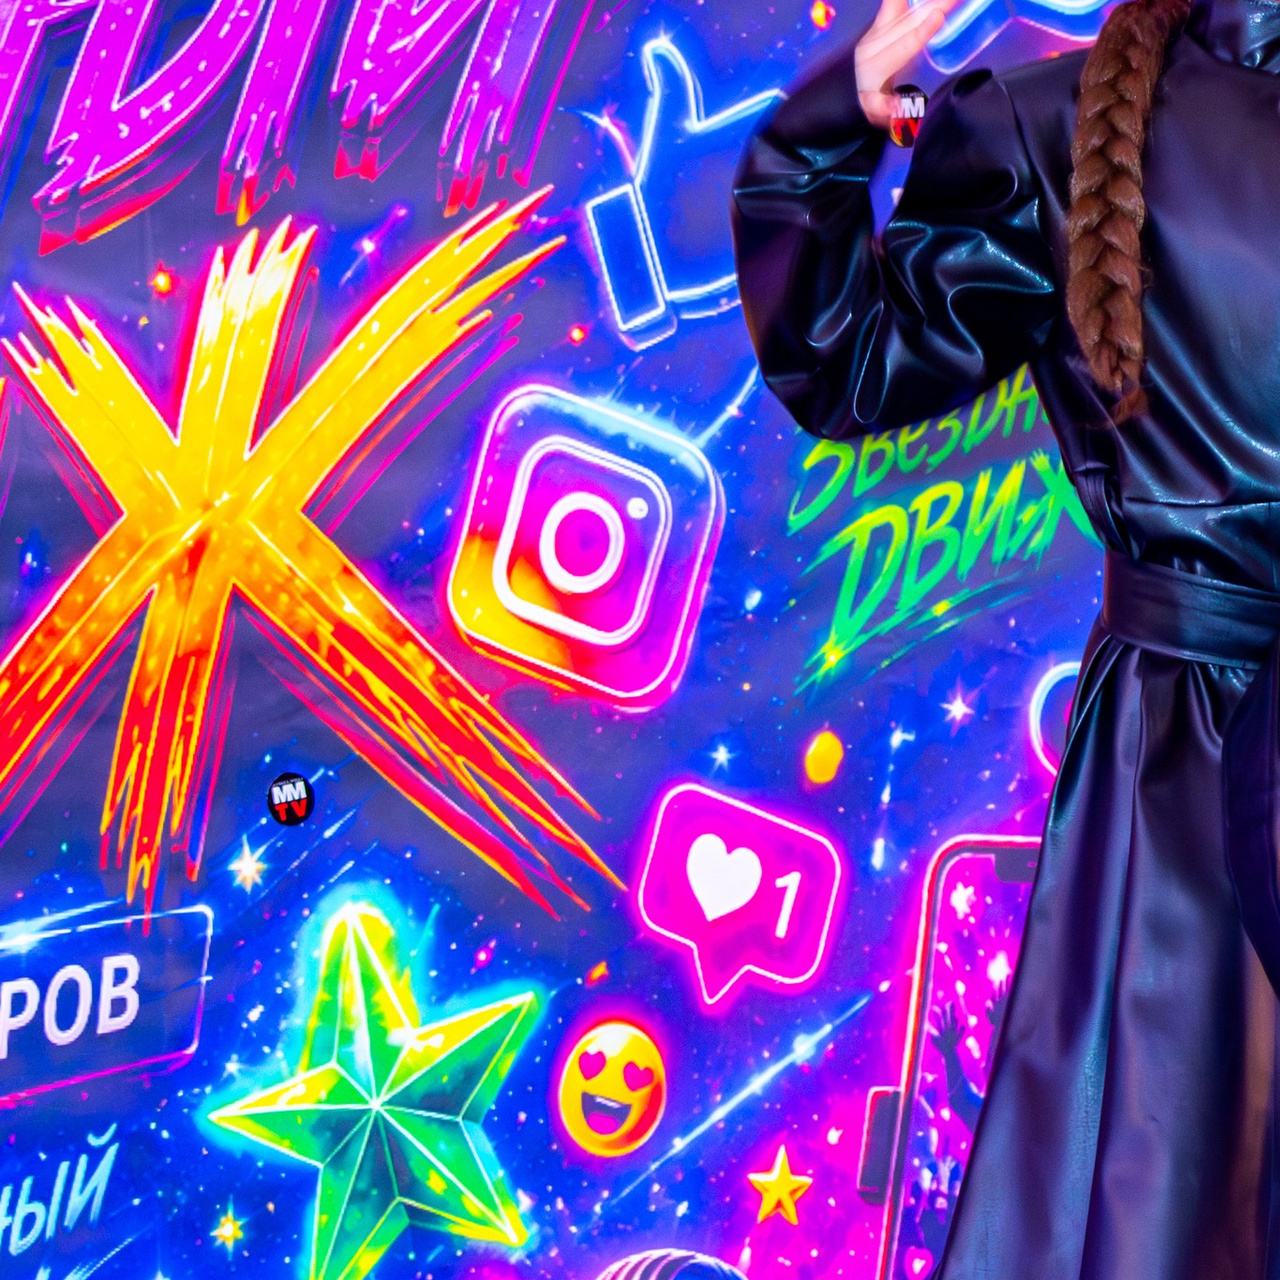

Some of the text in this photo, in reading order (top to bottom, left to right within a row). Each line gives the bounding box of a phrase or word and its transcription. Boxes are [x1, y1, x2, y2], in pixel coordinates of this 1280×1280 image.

[275, 798, 308, 821] TV
[774, 871, 802, 939] 1
[0, 953, 140, 1059] РОВ
